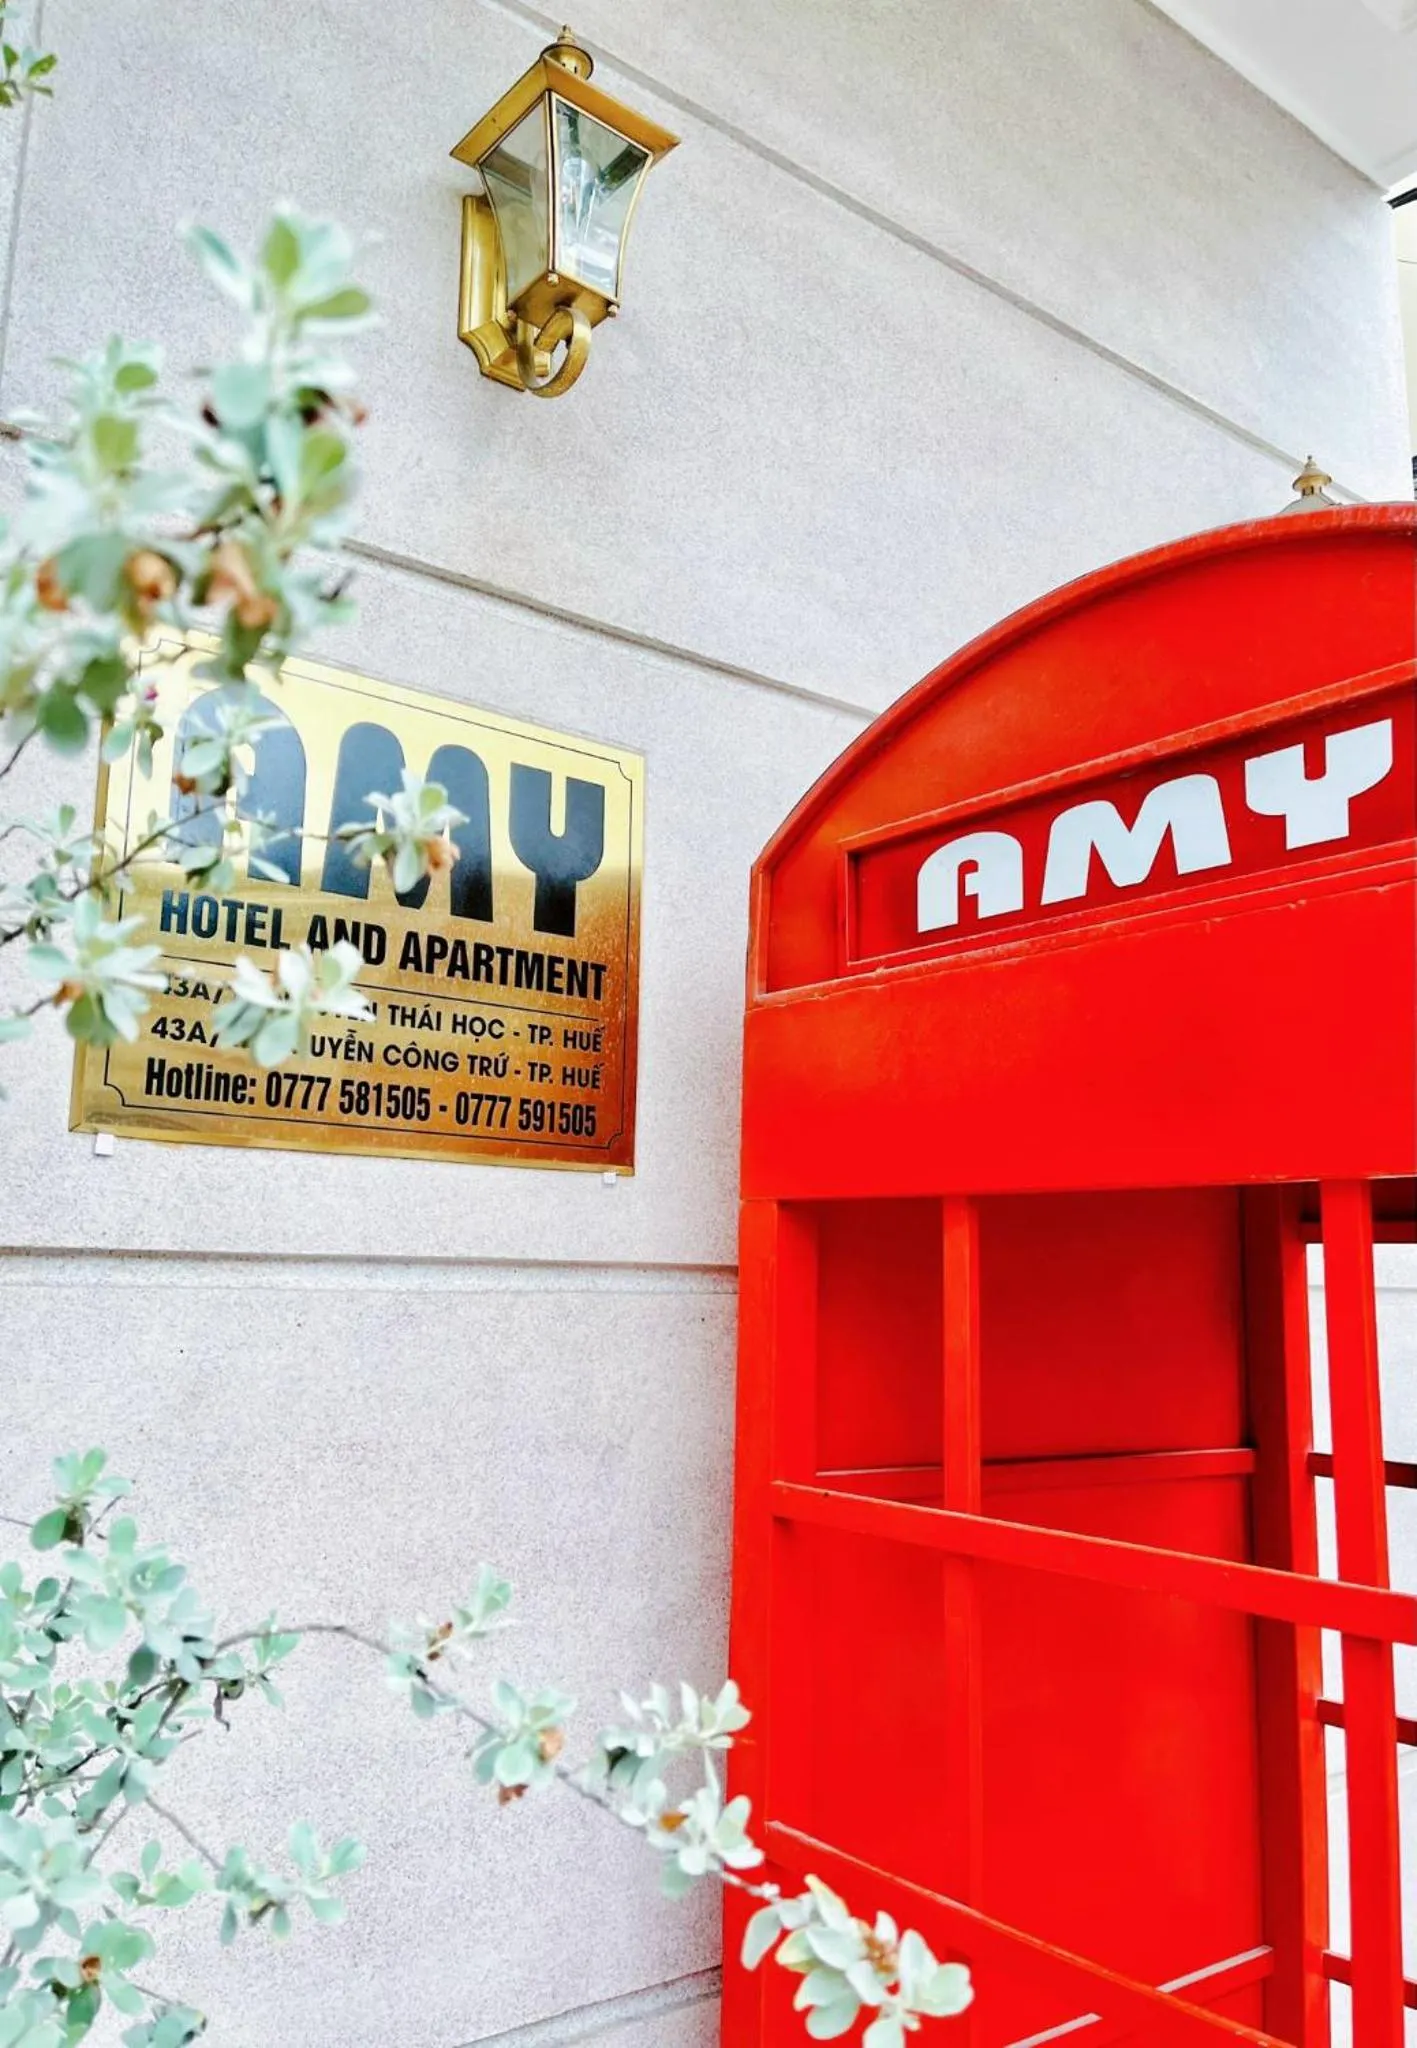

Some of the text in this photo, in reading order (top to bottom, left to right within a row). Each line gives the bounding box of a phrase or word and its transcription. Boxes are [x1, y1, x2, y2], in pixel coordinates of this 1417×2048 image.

[165, 686, 605, 937] AMY
[916, 717, 1393, 933] AMY
[160, 888, 607, 1001] HOTEL AND APARTMENT
[294, 1028, 375, 1063] UYỄN
[382, 1041, 460, 1073] CÔNG
[467, 1052, 510, 1078] TRỨ
[528, 1062, 554, 1084] TP.
[561, 1062, 606, 1090] HUẾ
[387, 1002, 442, 1032] THÁI
[451, 1012, 505, 1043] HỌC
[528, 1023, 554, 1046] TP.
[563, 1025, 606, 1053] HUẾ
[144, 1056, 257, 1105] Hotline:
[265, 1071, 332, 1112] 0777
[338, 1079, 431, 1122] 581505
[455, 1091, 512, 1129] 0777
[518, 1098, 598, 1137] 591505
